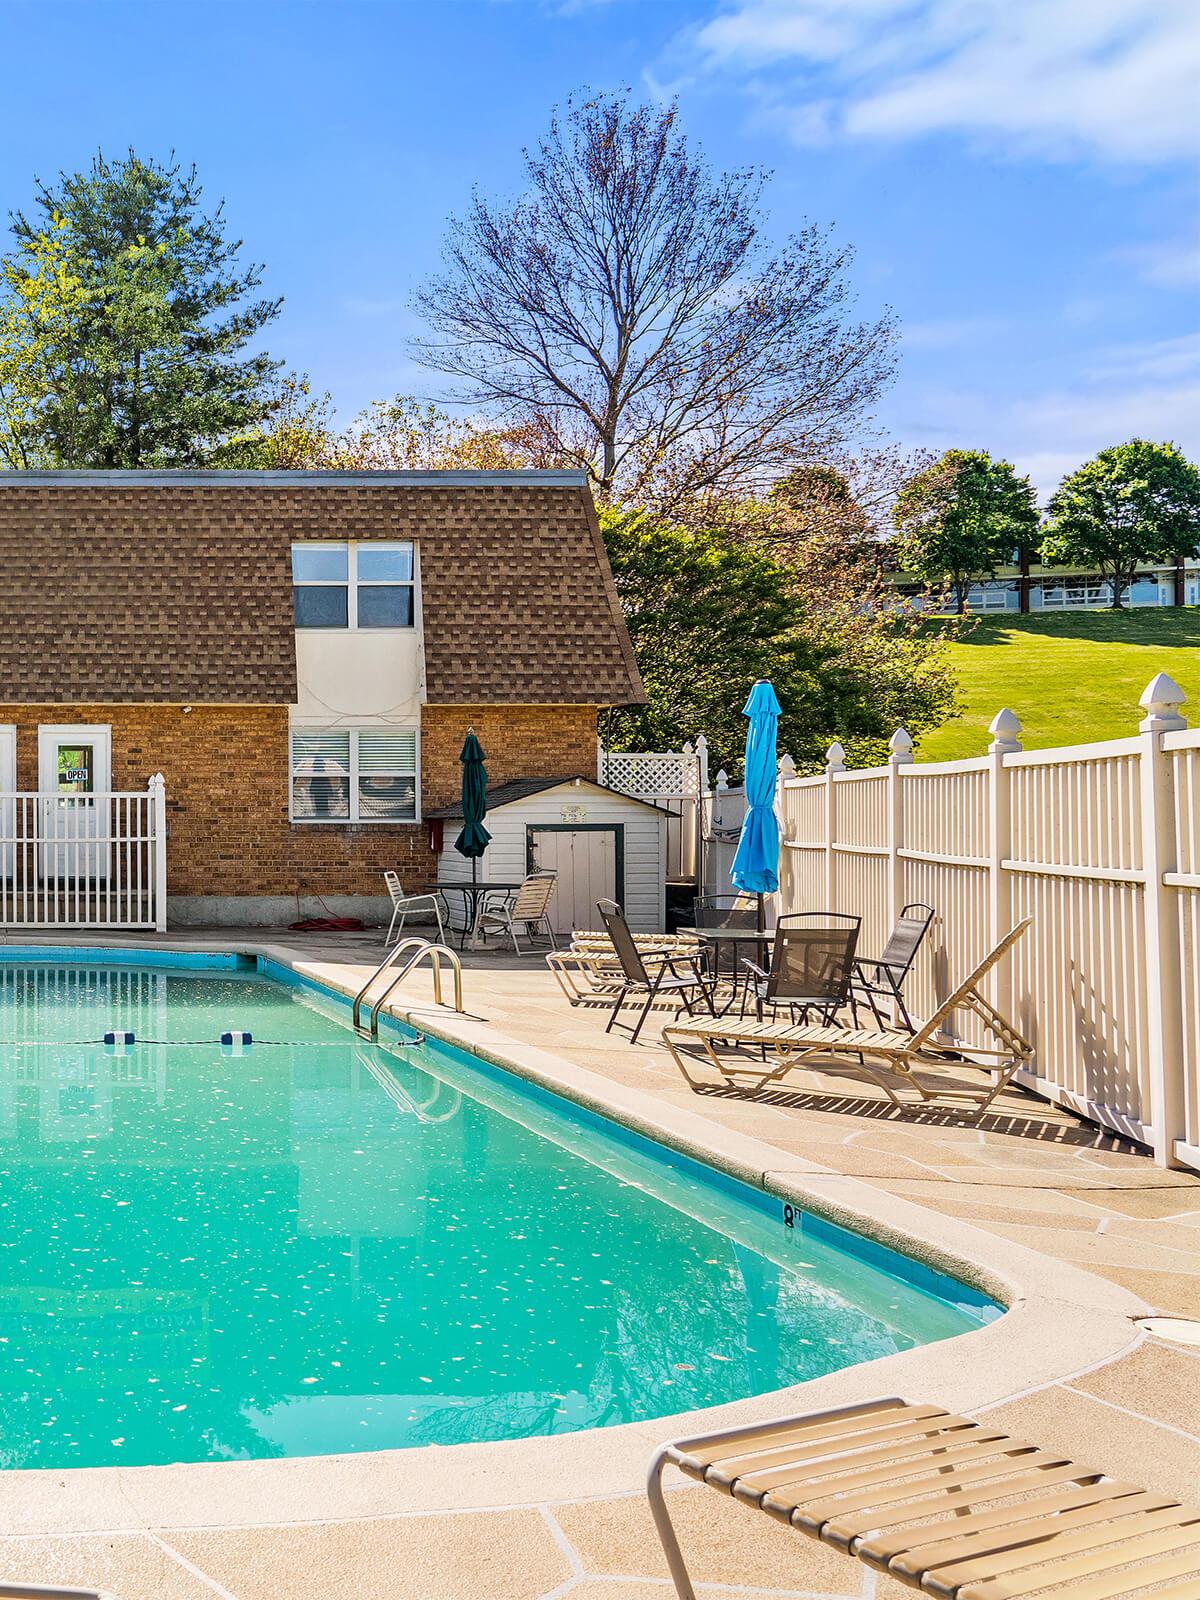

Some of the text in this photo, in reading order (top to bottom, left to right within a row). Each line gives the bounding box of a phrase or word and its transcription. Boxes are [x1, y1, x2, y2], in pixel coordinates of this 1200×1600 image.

[67, 770, 86, 779] OPEN
[784, 1204, 801, 1228] 8 FT
